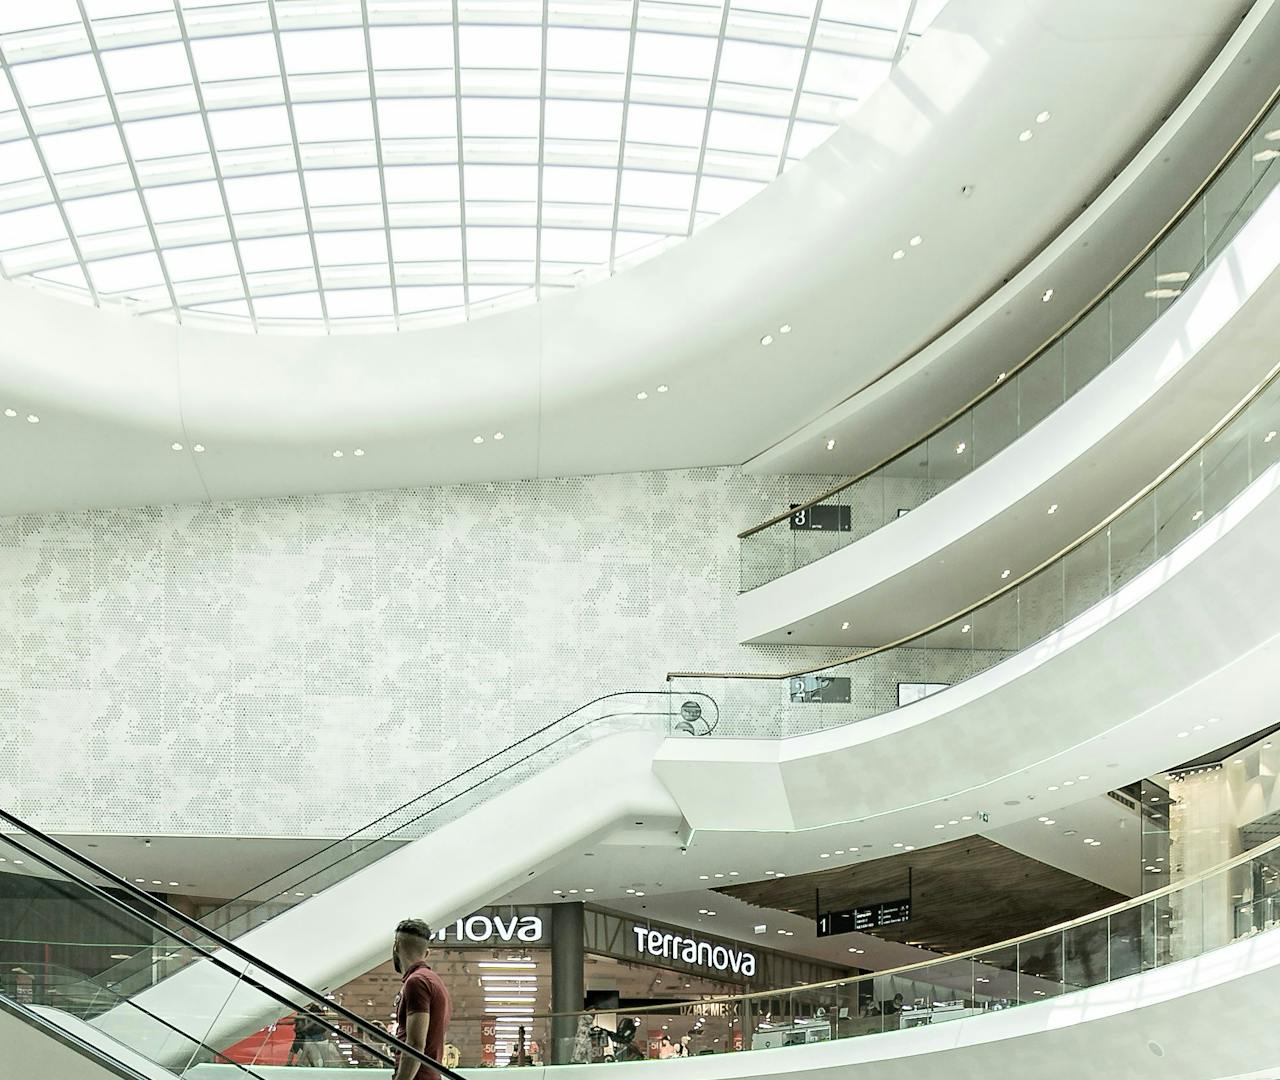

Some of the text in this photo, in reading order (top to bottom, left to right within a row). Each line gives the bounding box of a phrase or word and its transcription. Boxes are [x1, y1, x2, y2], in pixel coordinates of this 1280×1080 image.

[795, 510, 805, 525] 3
[795, 681, 805, 697] 2
[820, 918, 826, 932] 1
